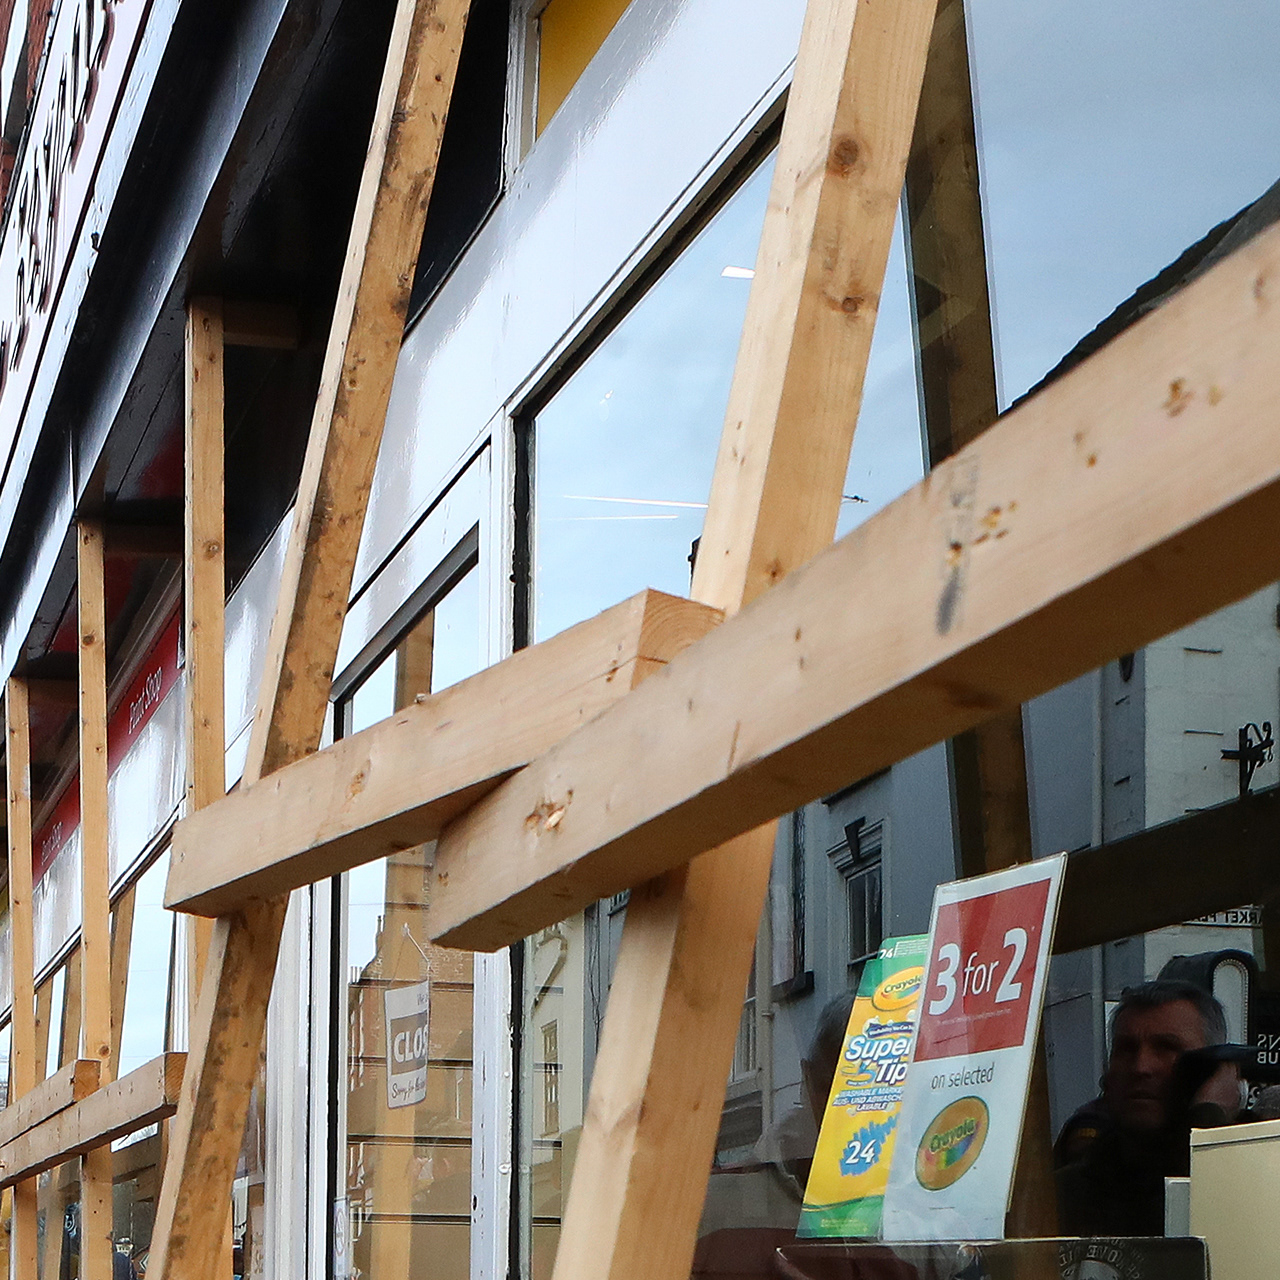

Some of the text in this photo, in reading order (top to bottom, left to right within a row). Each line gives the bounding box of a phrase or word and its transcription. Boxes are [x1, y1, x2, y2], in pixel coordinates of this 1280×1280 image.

[928, 927, 1029, 1016] 3 for 2
[931, 1061, 995, 1090] on selected
[930, 1117, 976, 1153] Crayola
[845, 1138, 877, 1165] 24
